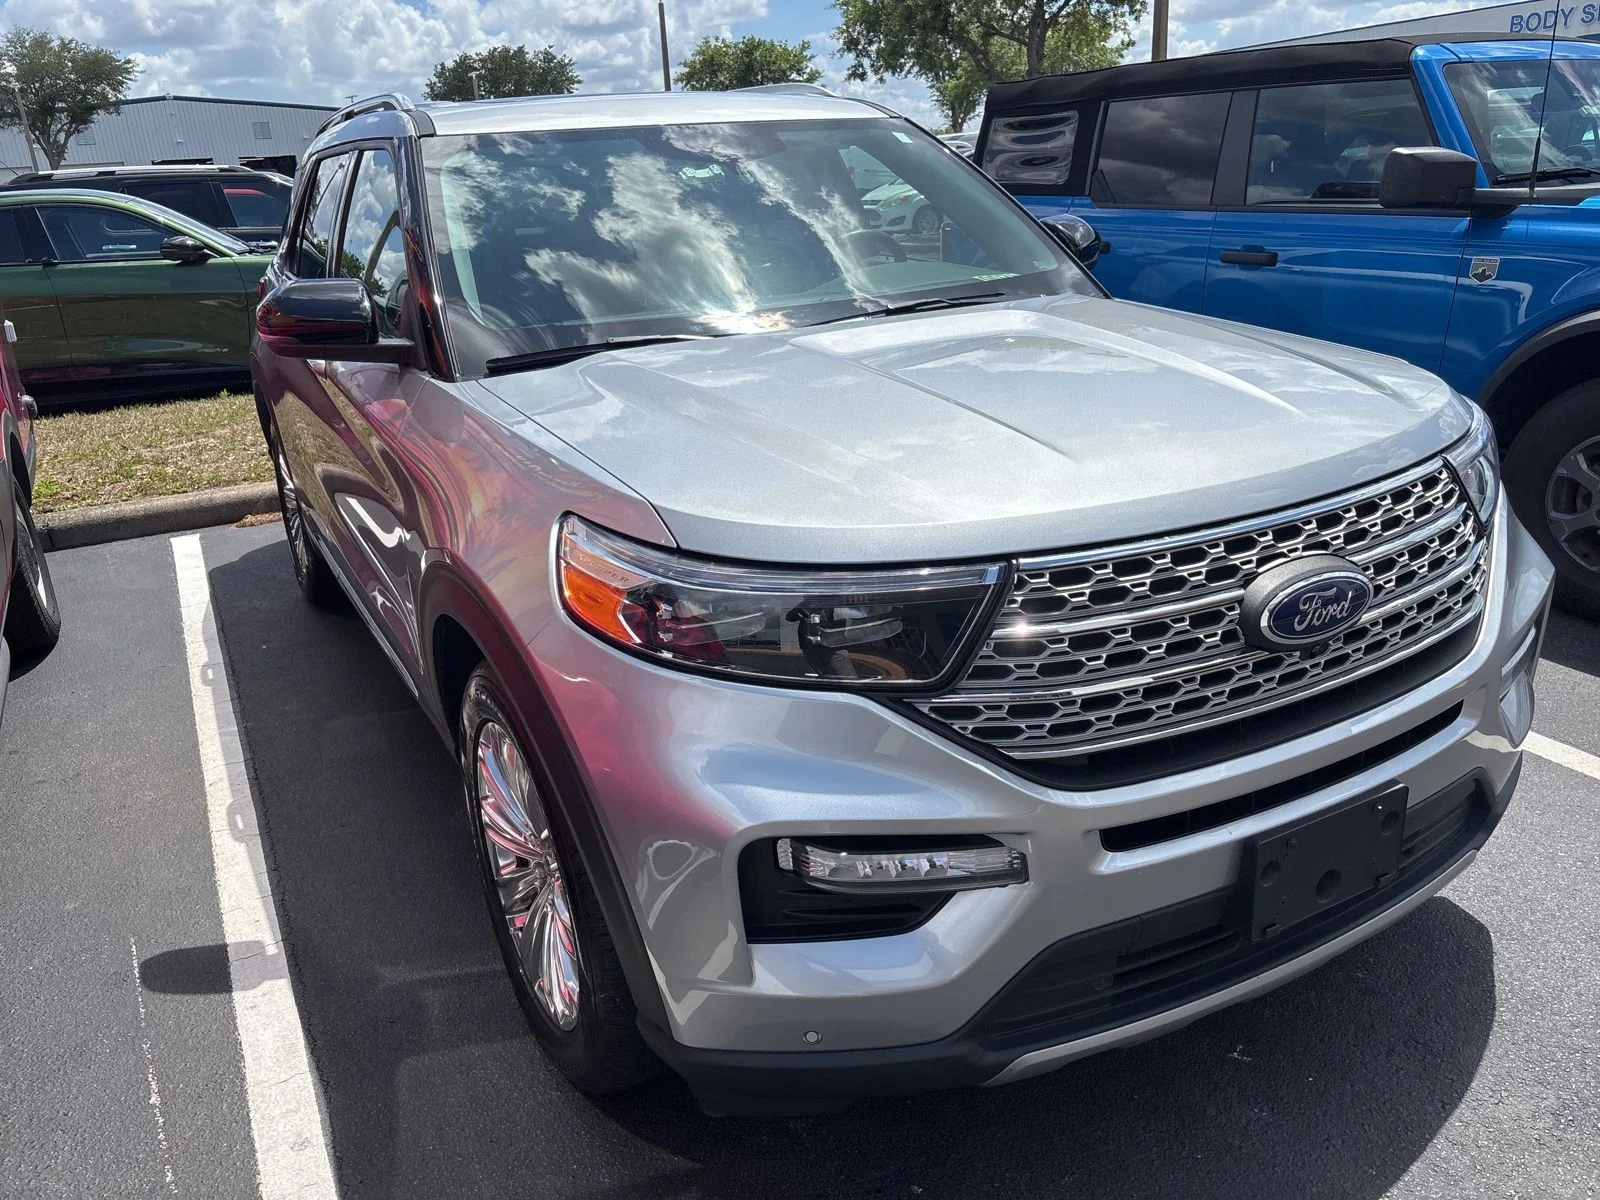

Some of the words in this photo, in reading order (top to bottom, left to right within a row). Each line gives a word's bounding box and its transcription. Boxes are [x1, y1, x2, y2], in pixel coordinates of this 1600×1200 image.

[1509, 6, 1575, 33] BODY
[1580, 3, 1600, 24] S
[1293, 586, 1353, 632] Ford
